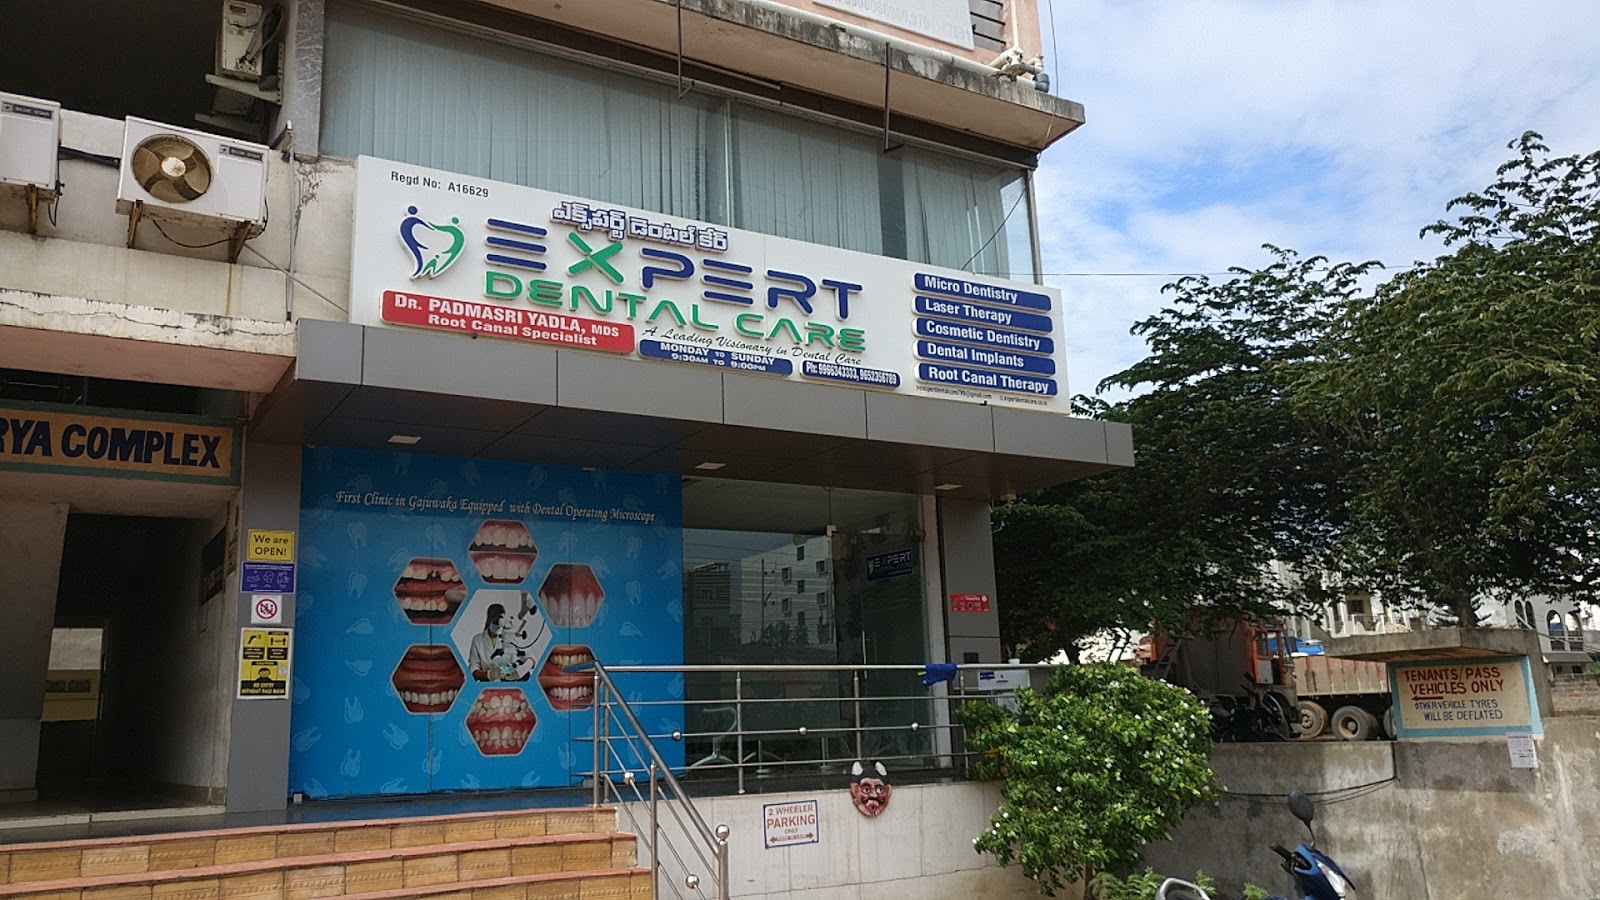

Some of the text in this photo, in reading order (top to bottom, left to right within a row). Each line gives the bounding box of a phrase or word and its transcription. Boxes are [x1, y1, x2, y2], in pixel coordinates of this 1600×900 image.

[391, 171, 489, 198] Regd No: A16629
[485, 218, 863, 320] EXPERT
[924, 276, 1018, 304] Micro Dentistry
[428, 297, 523, 324] PADMASRI
[527, 312, 586, 334] YADLA,
[591, 324, 619, 338] MDS
[485, 270, 866, 352] DENTAL CARE
[925, 298, 1012, 325] Laser Therapy
[428, 314, 598, 346] Root Canal Specialist
[926, 320, 1041, 351] Cosmetic Dentistry
[642, 326, 863, 366] A Leading Visionary in Dental Care
[660, 342, 710, 356] MONDAY
[730, 352, 776, 366] SUNDAY
[927, 343, 1024, 368] Dental Implants
[805, 361, 818, 374] Ph:
[928, 366, 1049, 394] Root Canal Therapy
[61, 424, 221, 469] COMPLEX
[335, 491, 656, 525] First Clinic in Gajuwaka Equipped with Dental Operating Microscope
[254, 535, 271, 544] We
[254, 547, 287, 556] OPEN!
[874, 551, 911, 568] EXPERT
[1409, 679, 1504, 695] VEHICLES ONLY
[1414, 699, 1498, 710] OTHER VEHICLE TYRES
[1424, 709, 1503, 722] WILL BE DEFLATED
[767, 815, 815, 829] PARKING
[775, 804, 813, 815] WHEELER
